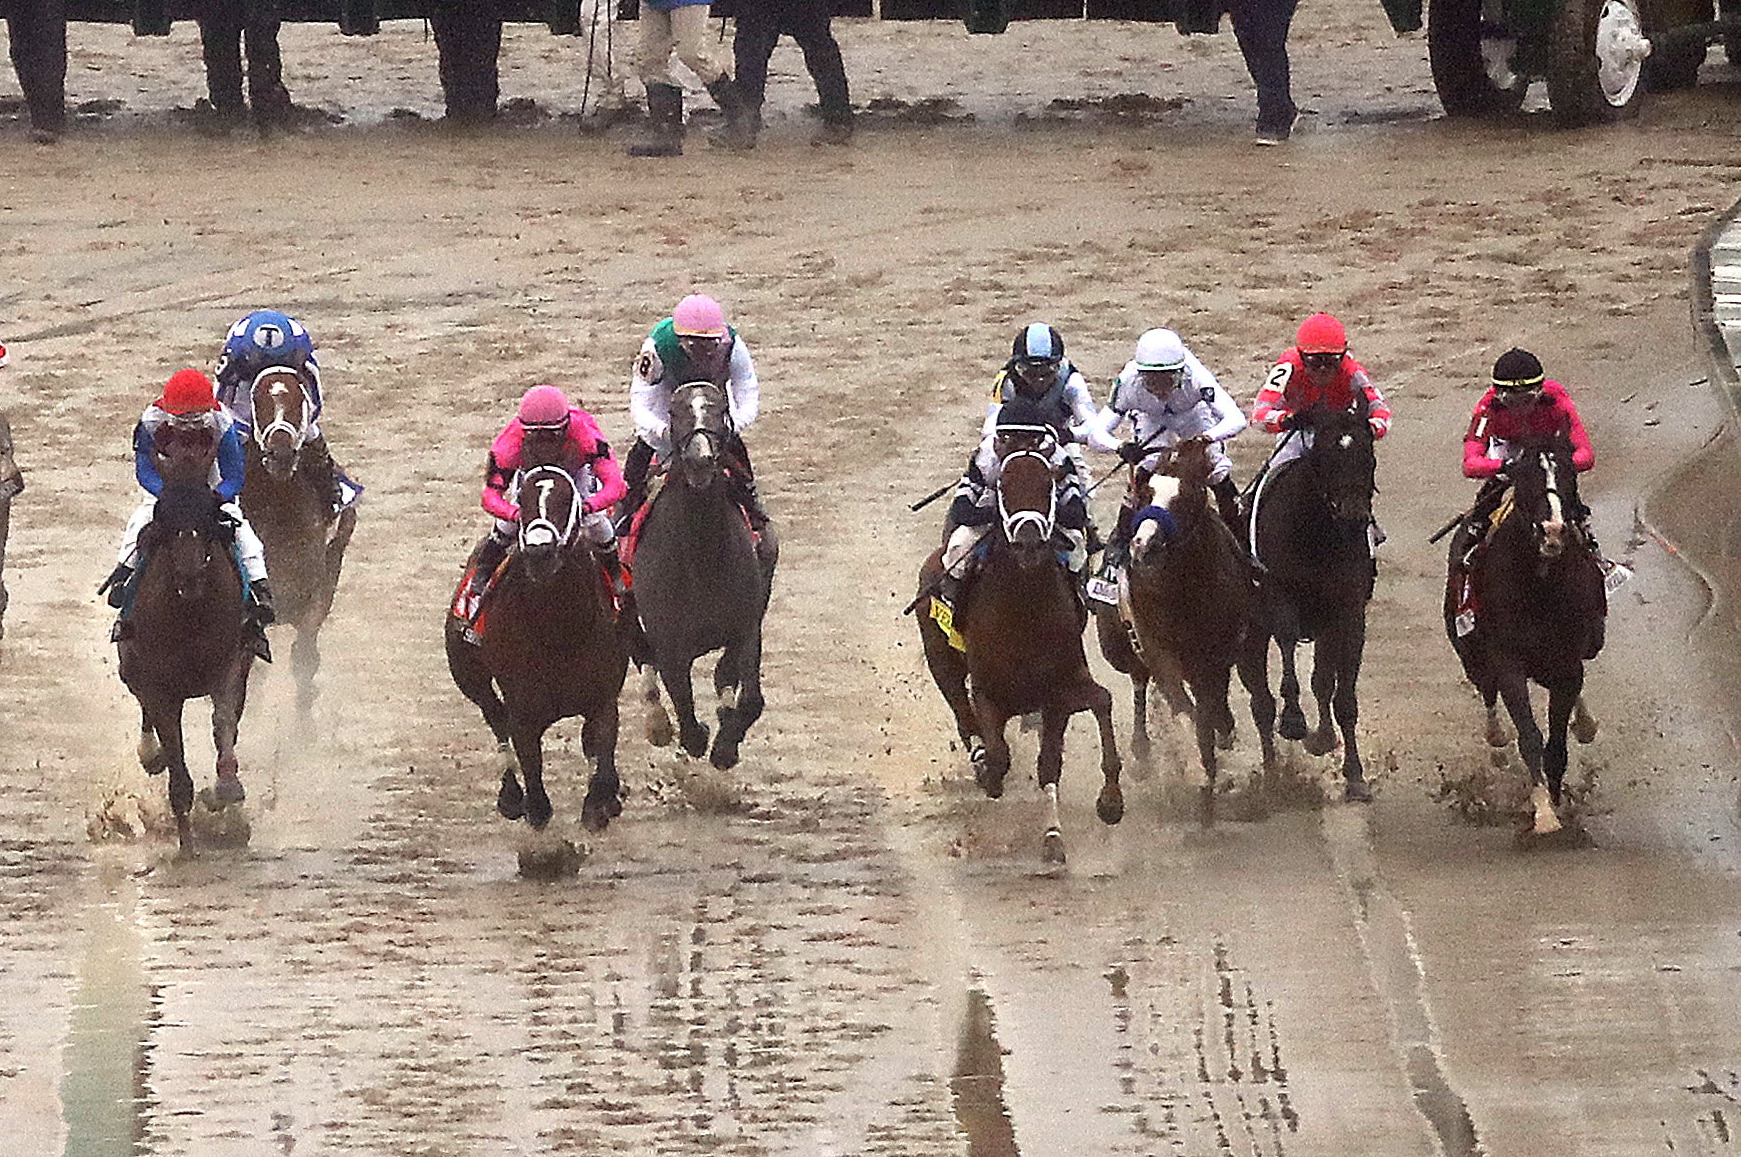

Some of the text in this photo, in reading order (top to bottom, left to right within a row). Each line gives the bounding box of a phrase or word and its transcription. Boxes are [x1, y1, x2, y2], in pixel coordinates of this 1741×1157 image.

[259, 326, 280, 347] T
[1270, 368, 1287, 387] 2
[1475, 417, 1489, 438] 1
